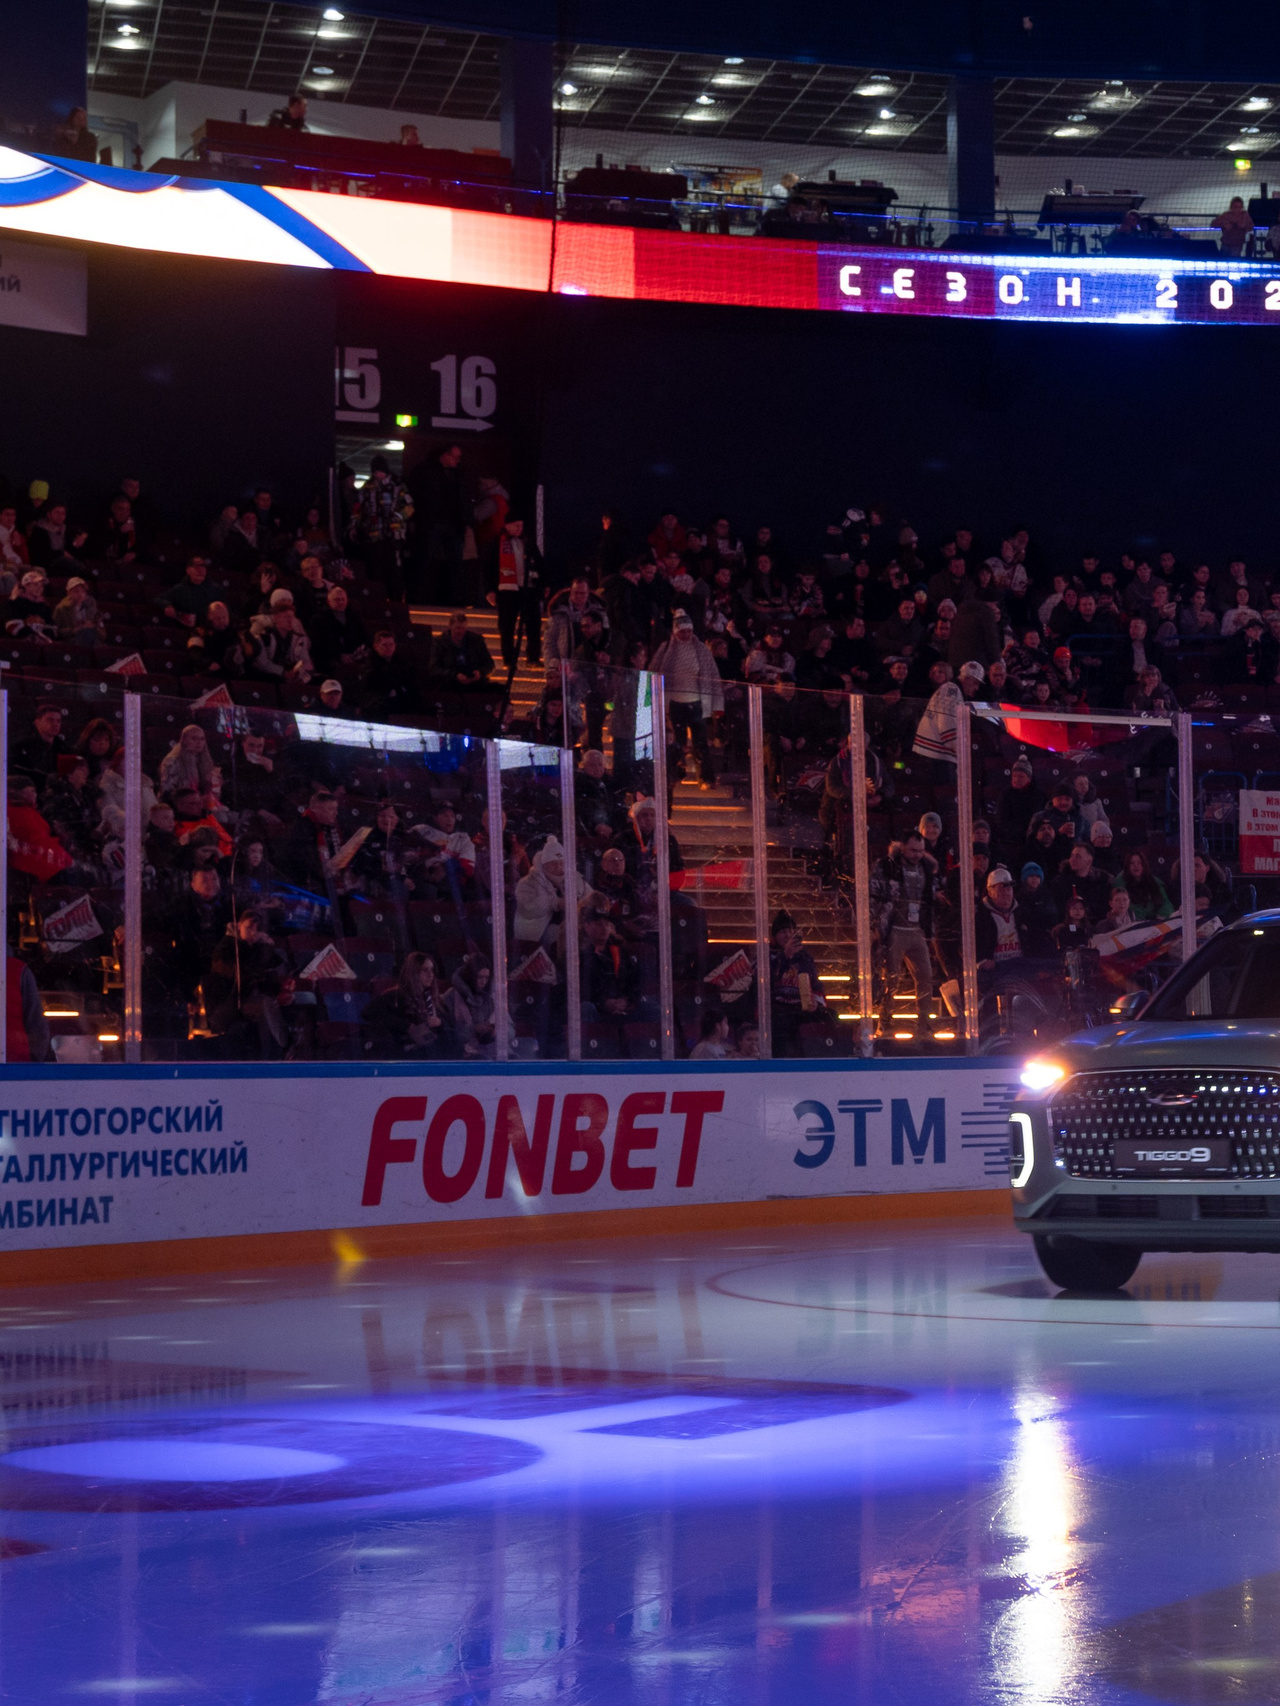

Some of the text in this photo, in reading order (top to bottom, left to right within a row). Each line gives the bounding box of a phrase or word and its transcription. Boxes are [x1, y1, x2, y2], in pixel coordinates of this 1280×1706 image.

[839, 264, 1080, 307] СЕЗОН
[430, 354, 497, 417] 16
[0, 1140, 248, 1183] АЛЛУРГИЧЕСКИЙ
[361, 1090, 725, 1207] FONBET
[793, 1097, 946, 1169] ЭТМ
